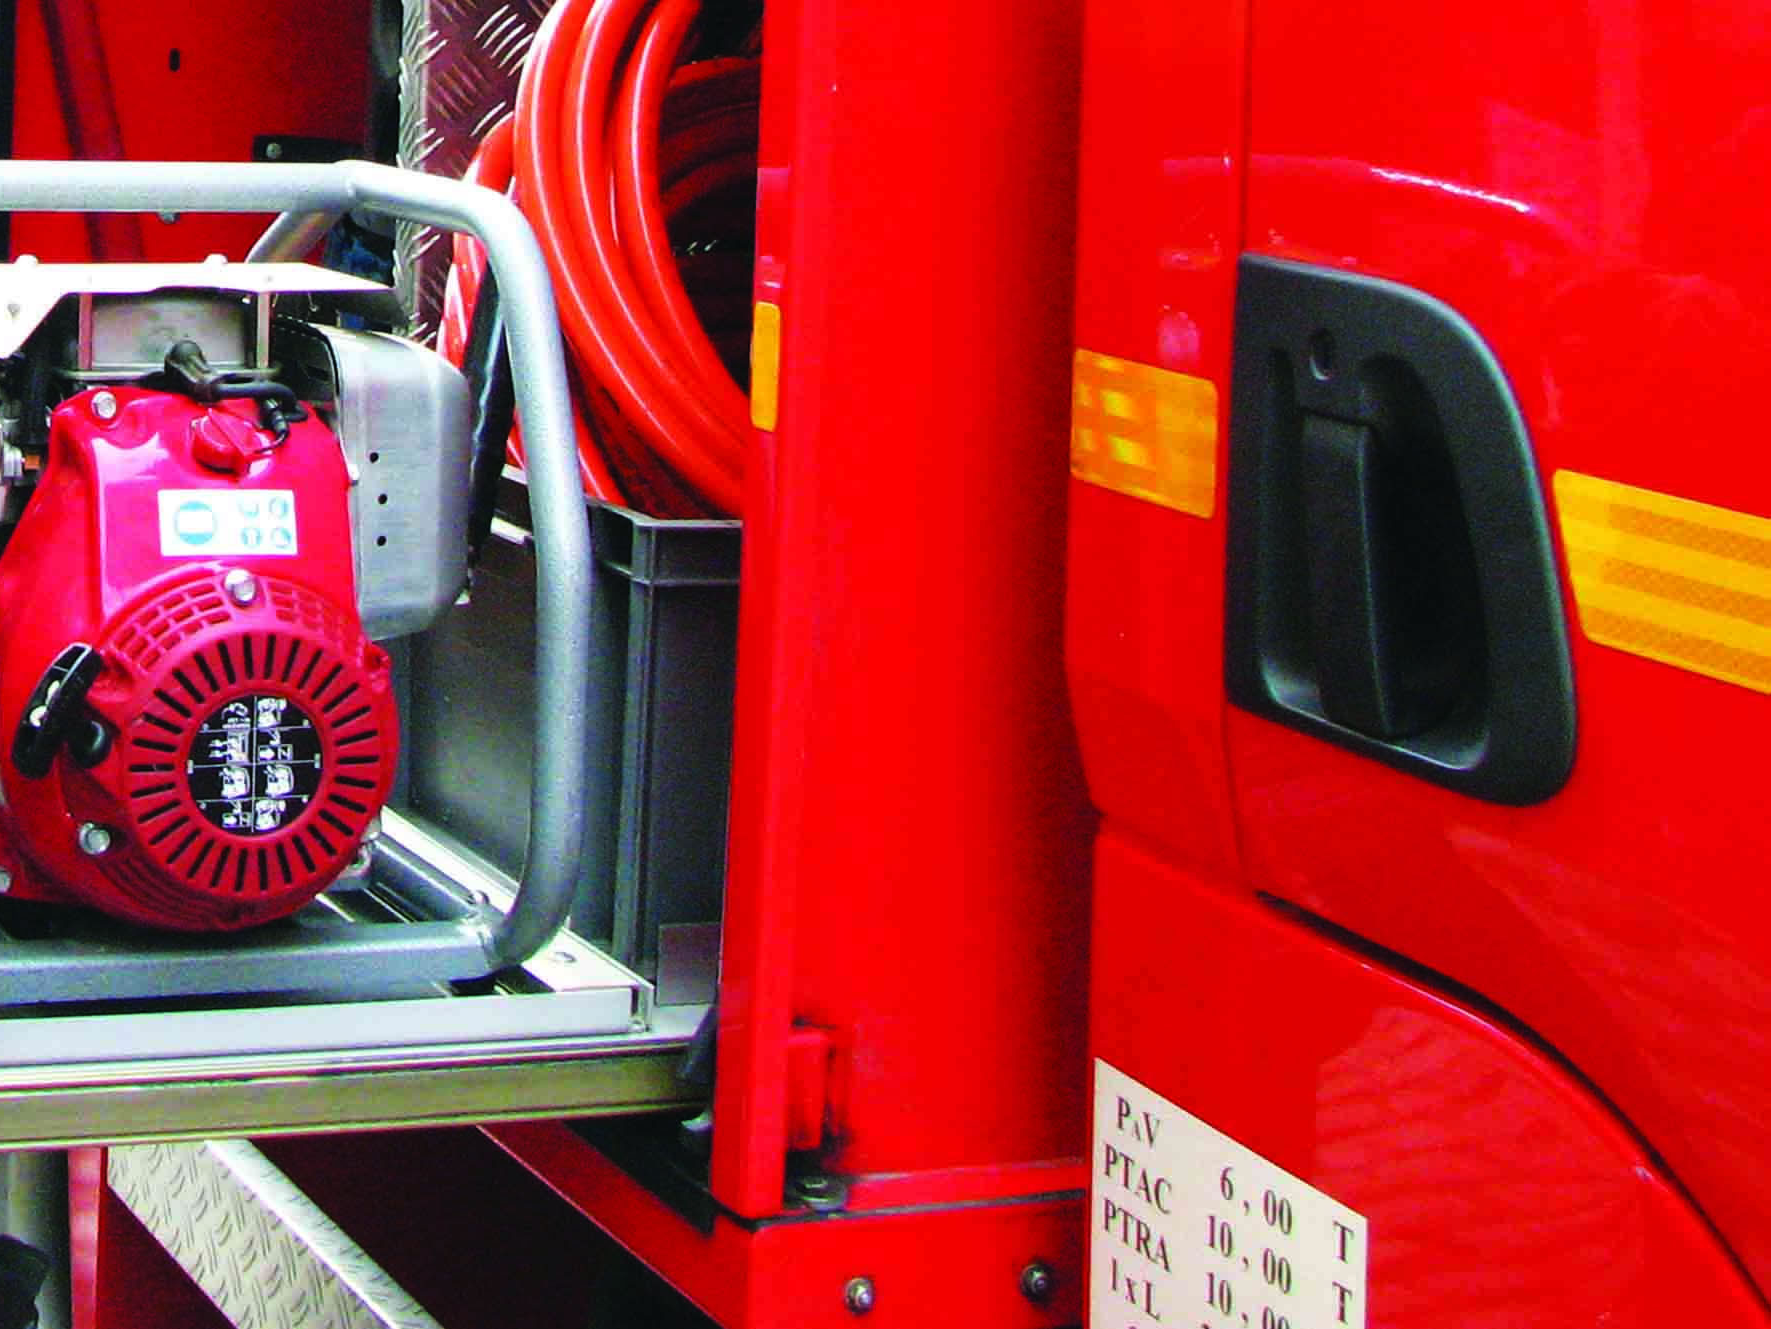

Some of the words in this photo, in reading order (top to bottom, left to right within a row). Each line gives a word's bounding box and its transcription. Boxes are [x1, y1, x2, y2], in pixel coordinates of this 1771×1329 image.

[1103, 1197, 1172, 1274] PTRA
[1104, 1142, 1173, 1215] PTAC
[1332, 1280, 1353, 1324] T
[1333, 1220, 1355, 1264] T
